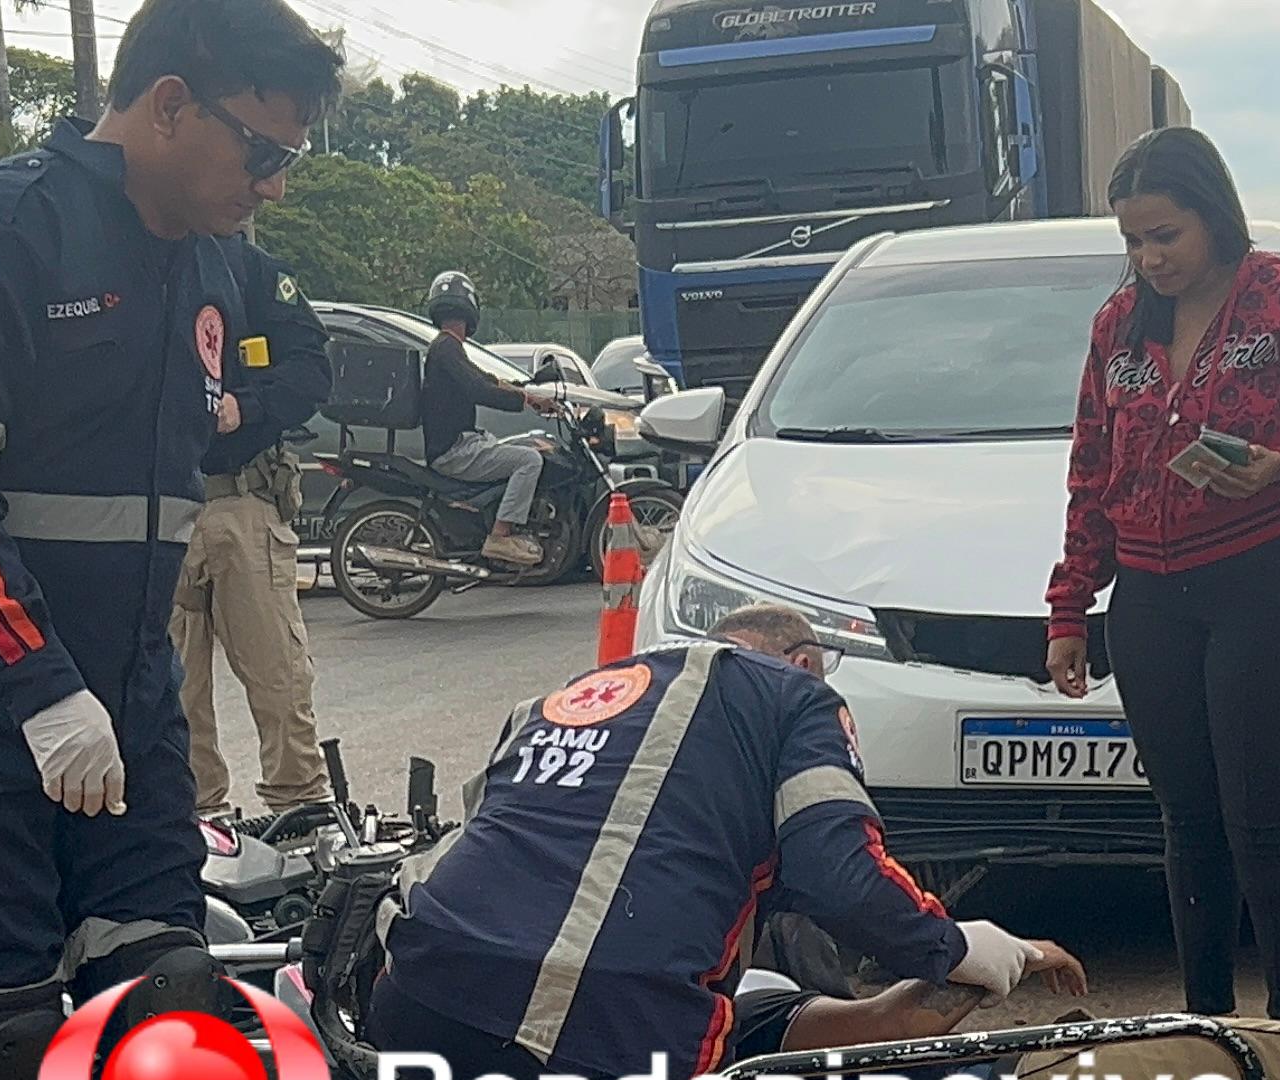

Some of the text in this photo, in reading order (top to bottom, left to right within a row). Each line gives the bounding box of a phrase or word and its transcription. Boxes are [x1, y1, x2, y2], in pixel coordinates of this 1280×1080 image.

[721, 2, 877, 29] GLOBETROTTER
[681, 290, 723, 301] VOLVO
[1050, 725, 1085, 735] BRASIL
[512, 746, 595, 787] 192
[965, 767, 977, 779] BR
